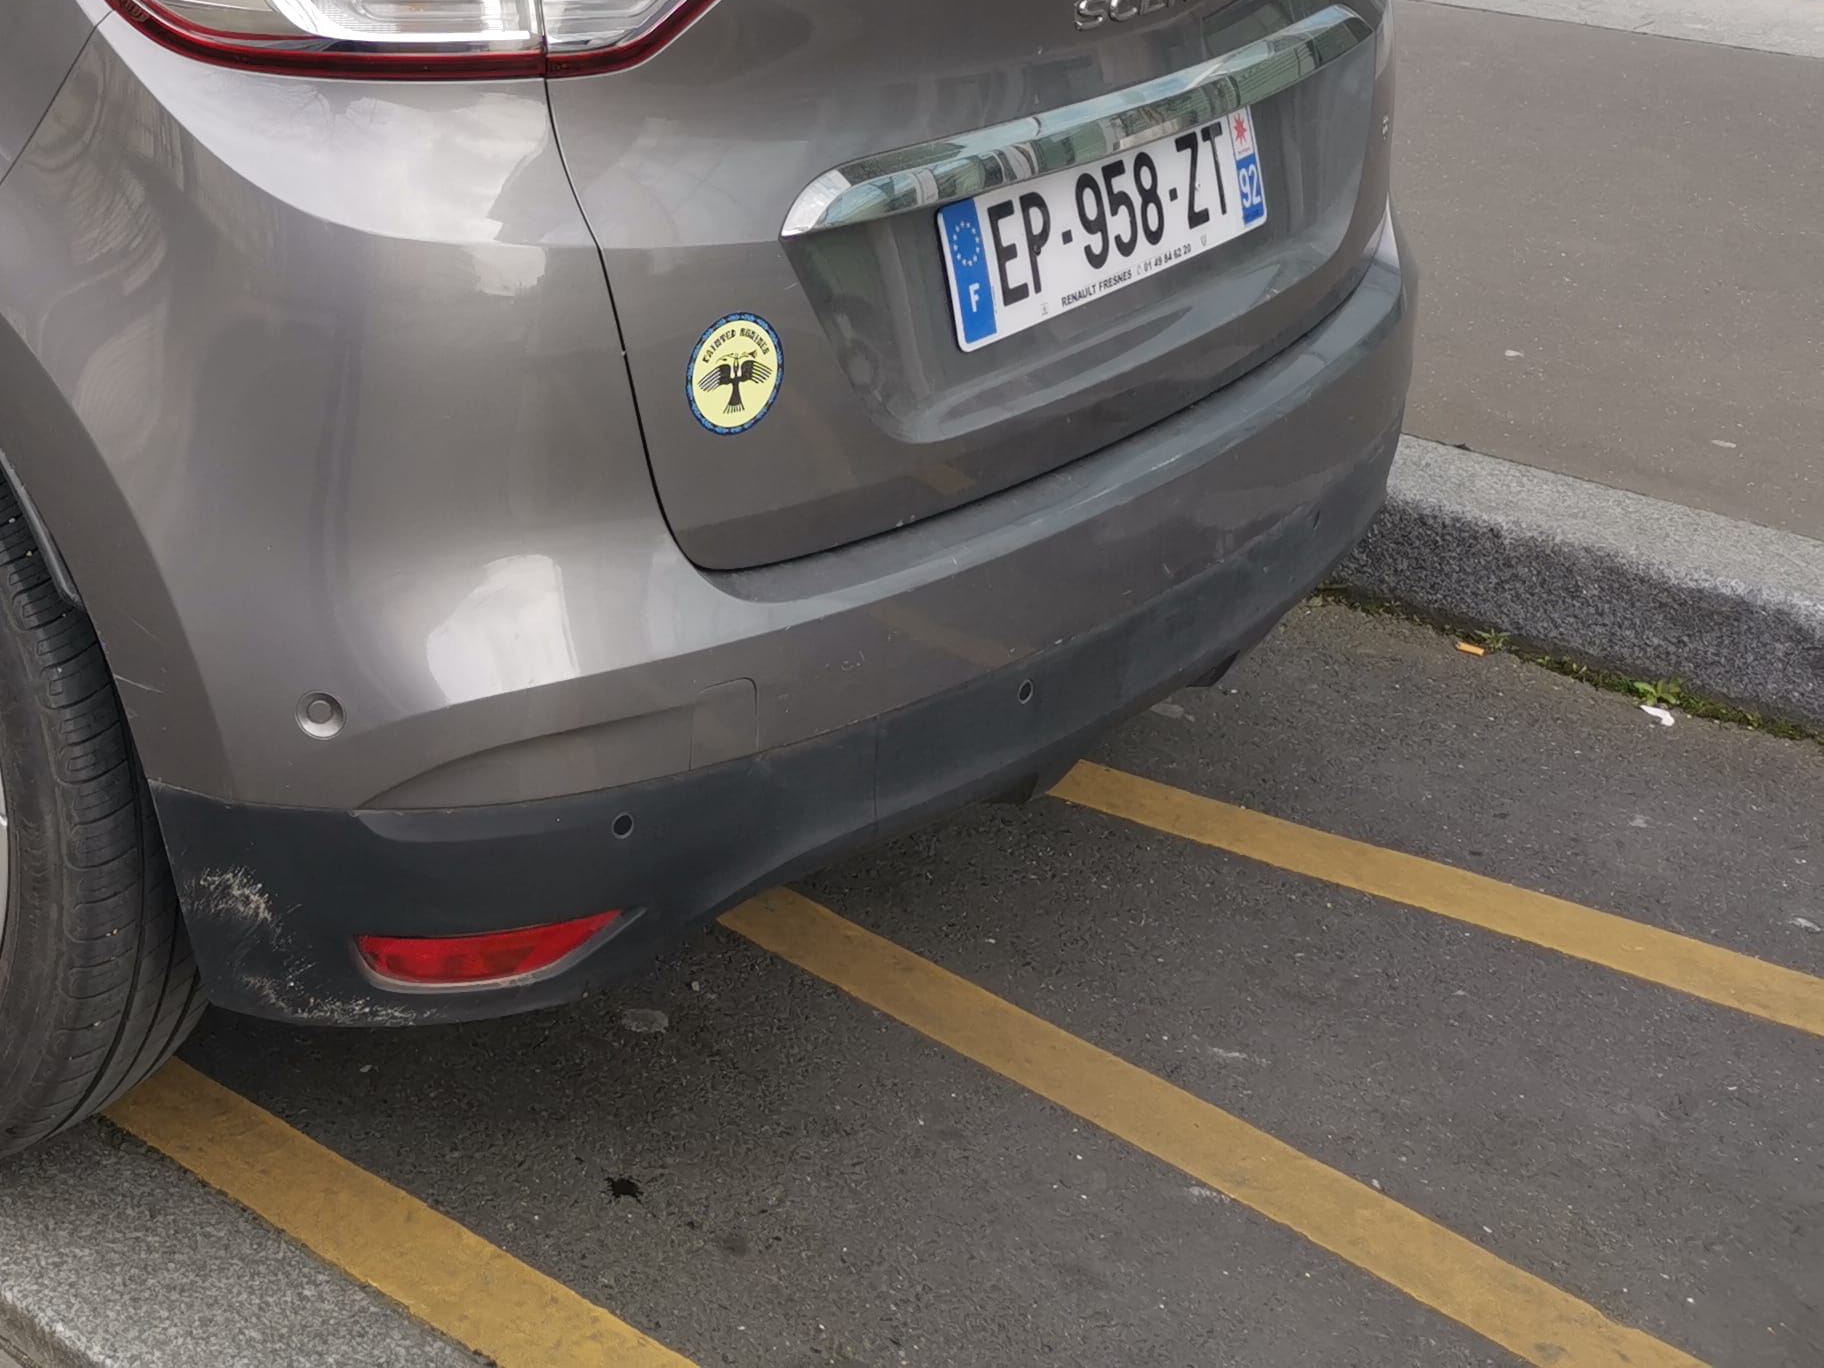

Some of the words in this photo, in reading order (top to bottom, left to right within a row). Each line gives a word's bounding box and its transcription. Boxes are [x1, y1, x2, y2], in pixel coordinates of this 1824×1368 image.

[1239, 163, 1262, 208] 92
[986, 120, 1227, 308] EP-958-ZT
[968, 282, 981, 313] F
[1061, 284, 1097, 308] RENAULT
[1098, 269, 1133, 292] FRESNES
